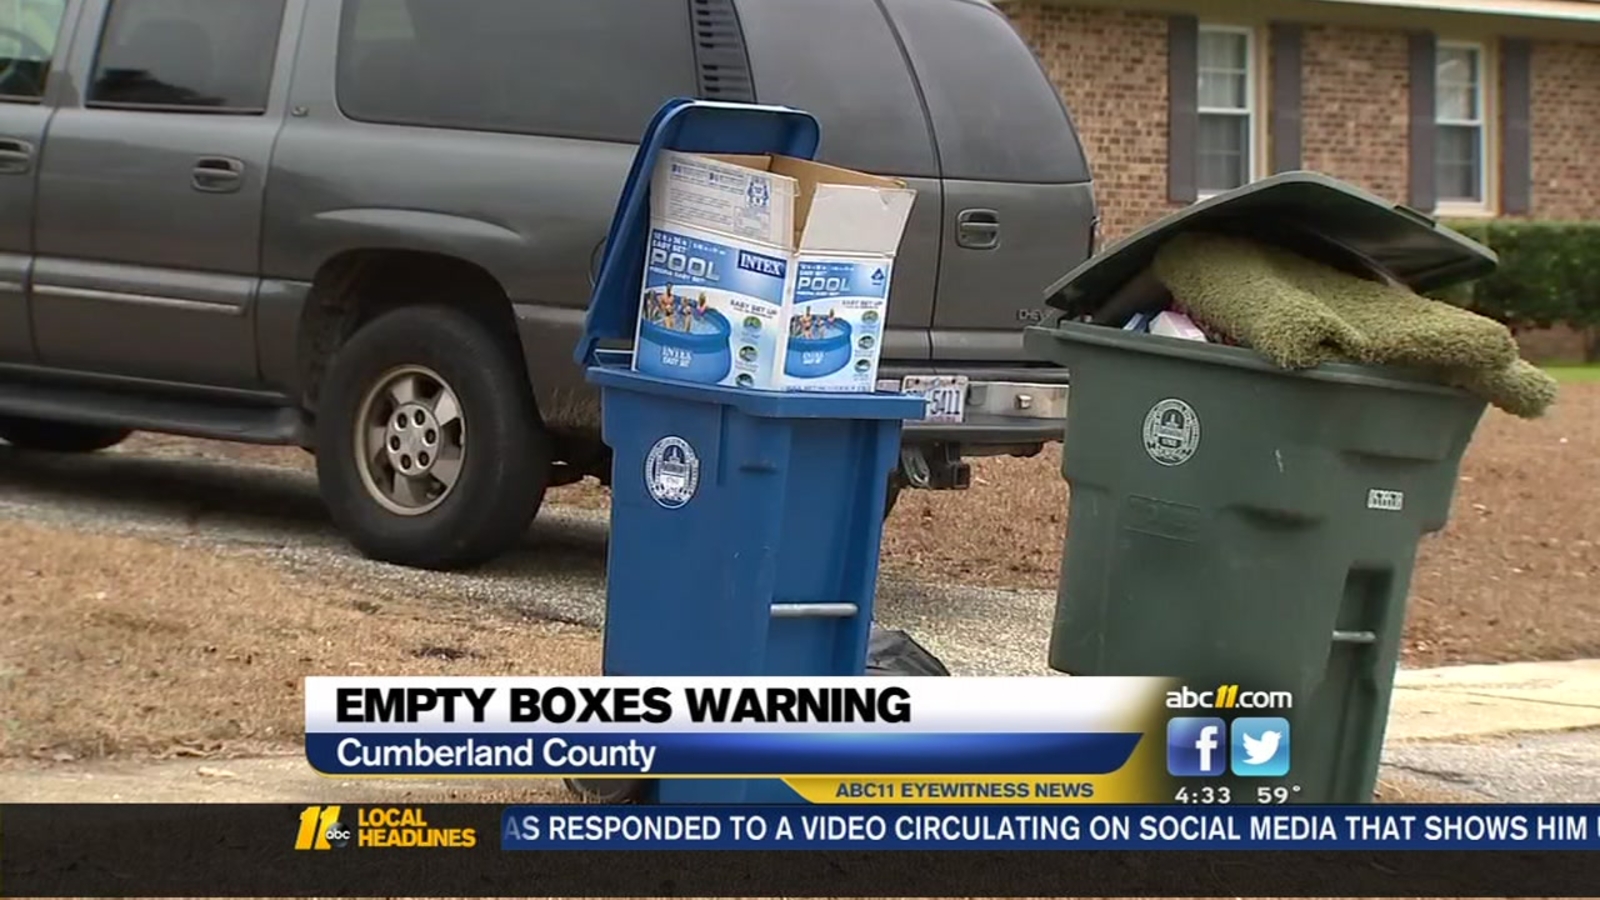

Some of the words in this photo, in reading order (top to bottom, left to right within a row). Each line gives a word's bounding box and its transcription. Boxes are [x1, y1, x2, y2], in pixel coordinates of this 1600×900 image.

[651, 248, 720, 281] POOL
[740, 252, 782, 276] INTEX
[797, 276, 851, 292] POOL
[730, 299, 750, 309] EASY
[751, 304, 766, 313] SET
